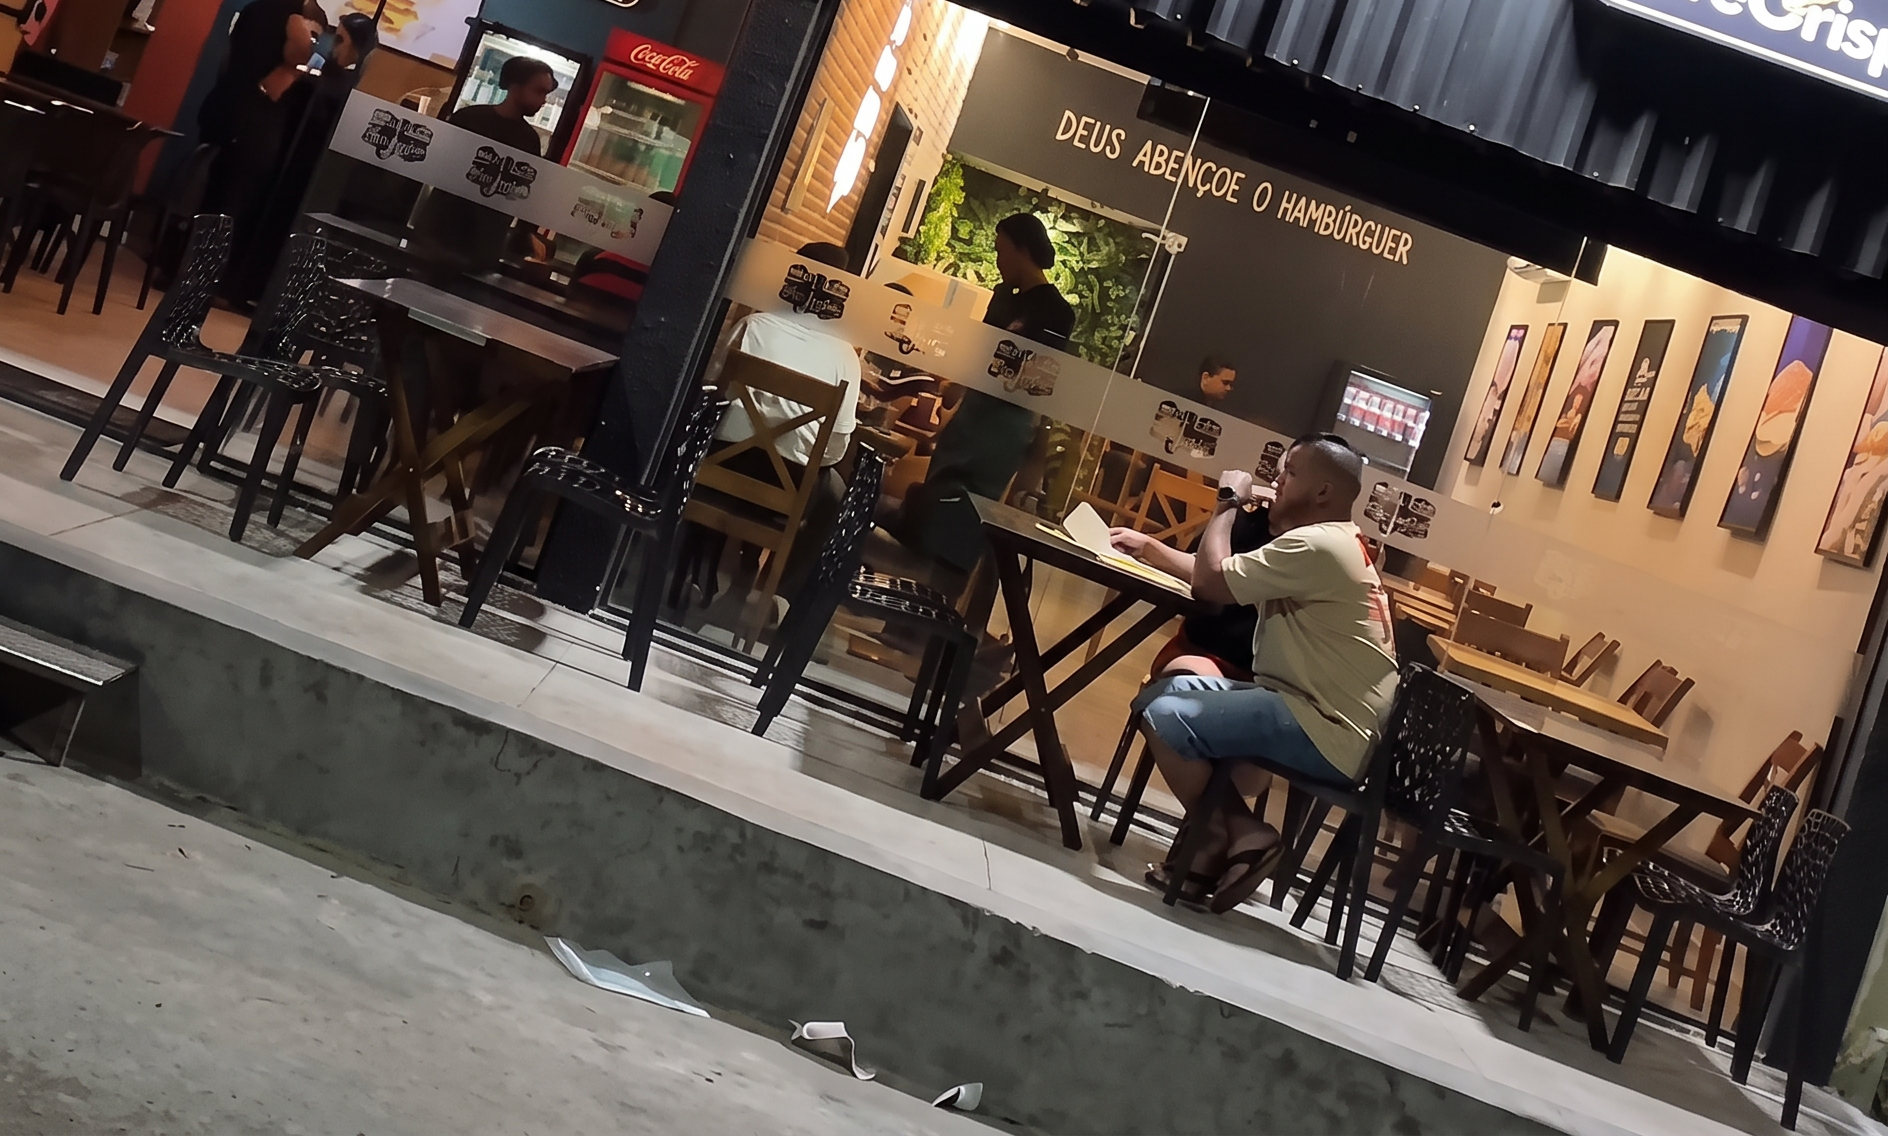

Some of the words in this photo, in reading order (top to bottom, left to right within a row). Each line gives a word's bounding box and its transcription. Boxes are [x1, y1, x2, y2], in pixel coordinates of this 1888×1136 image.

[1055, 109, 1126, 160] DEUS
[1131, 139, 1246, 204] ABENÇOE
[1252, 181, 1273, 212] O
[1276, 190, 1413, 265] HAMBÚRGUER
